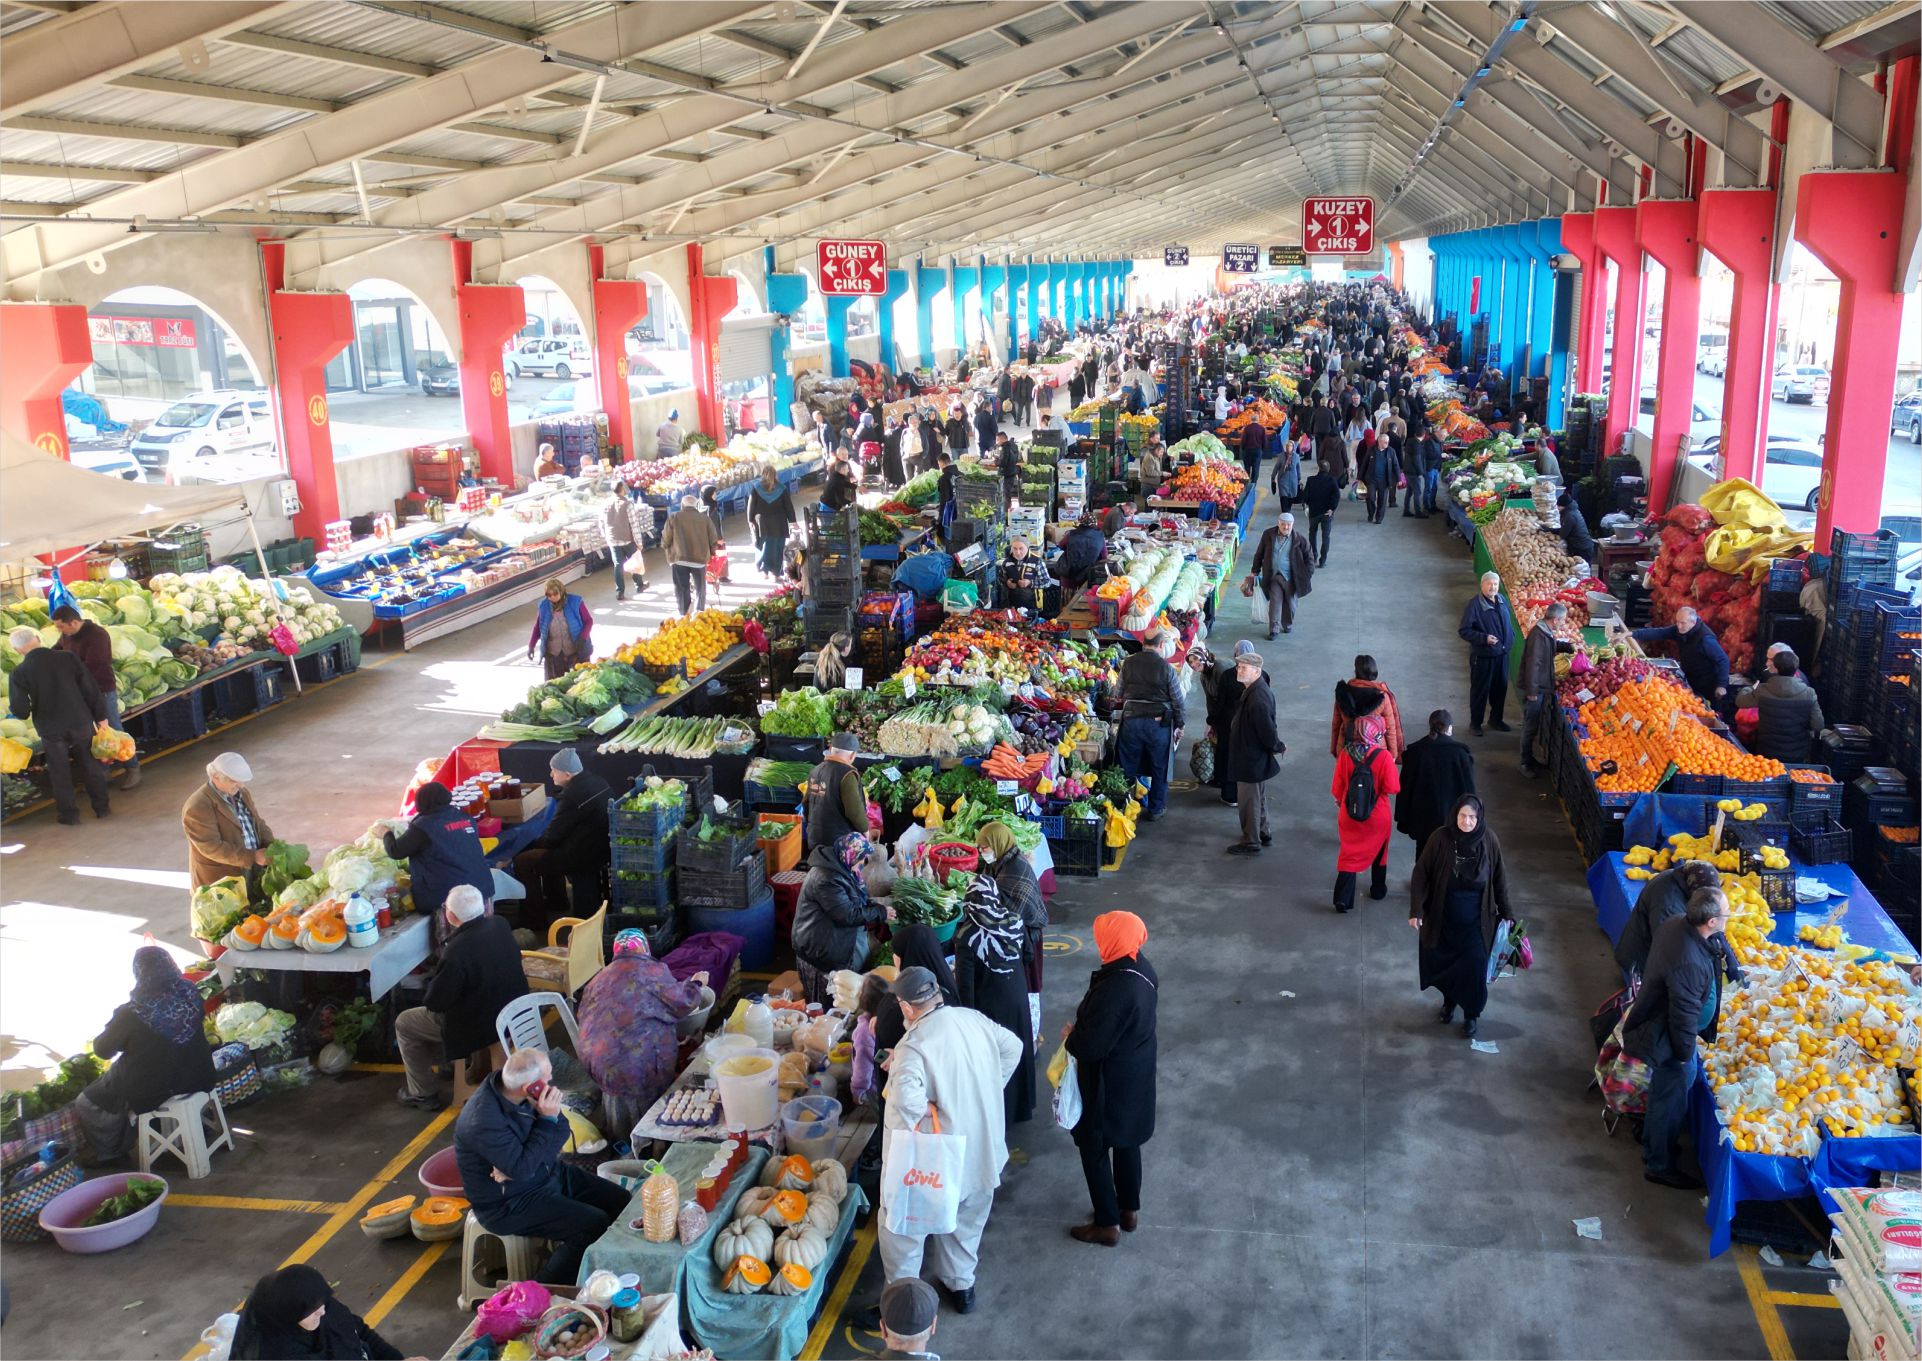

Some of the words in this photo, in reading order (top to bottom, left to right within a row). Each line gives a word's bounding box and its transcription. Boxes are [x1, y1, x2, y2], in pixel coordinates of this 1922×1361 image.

[1313, 201, 1367, 216] KUZEY
[1332, 217, 1342, 236] 1
[825, 242, 878, 259] GÜNEY
[1226, 245, 1257, 254] ÜRETİCİ
[1317, 237, 1358, 251] ÇIKIŞ
[1229, 254, 1254, 262] PAZARI
[846, 260, 856, 278] 1
[1236, 261, 1244, 271] 2
[833, 279, 872, 292] ÇIKIŞ
[312, 402, 324, 420] 40
[1840, 1039, 1849, 1051] 7
